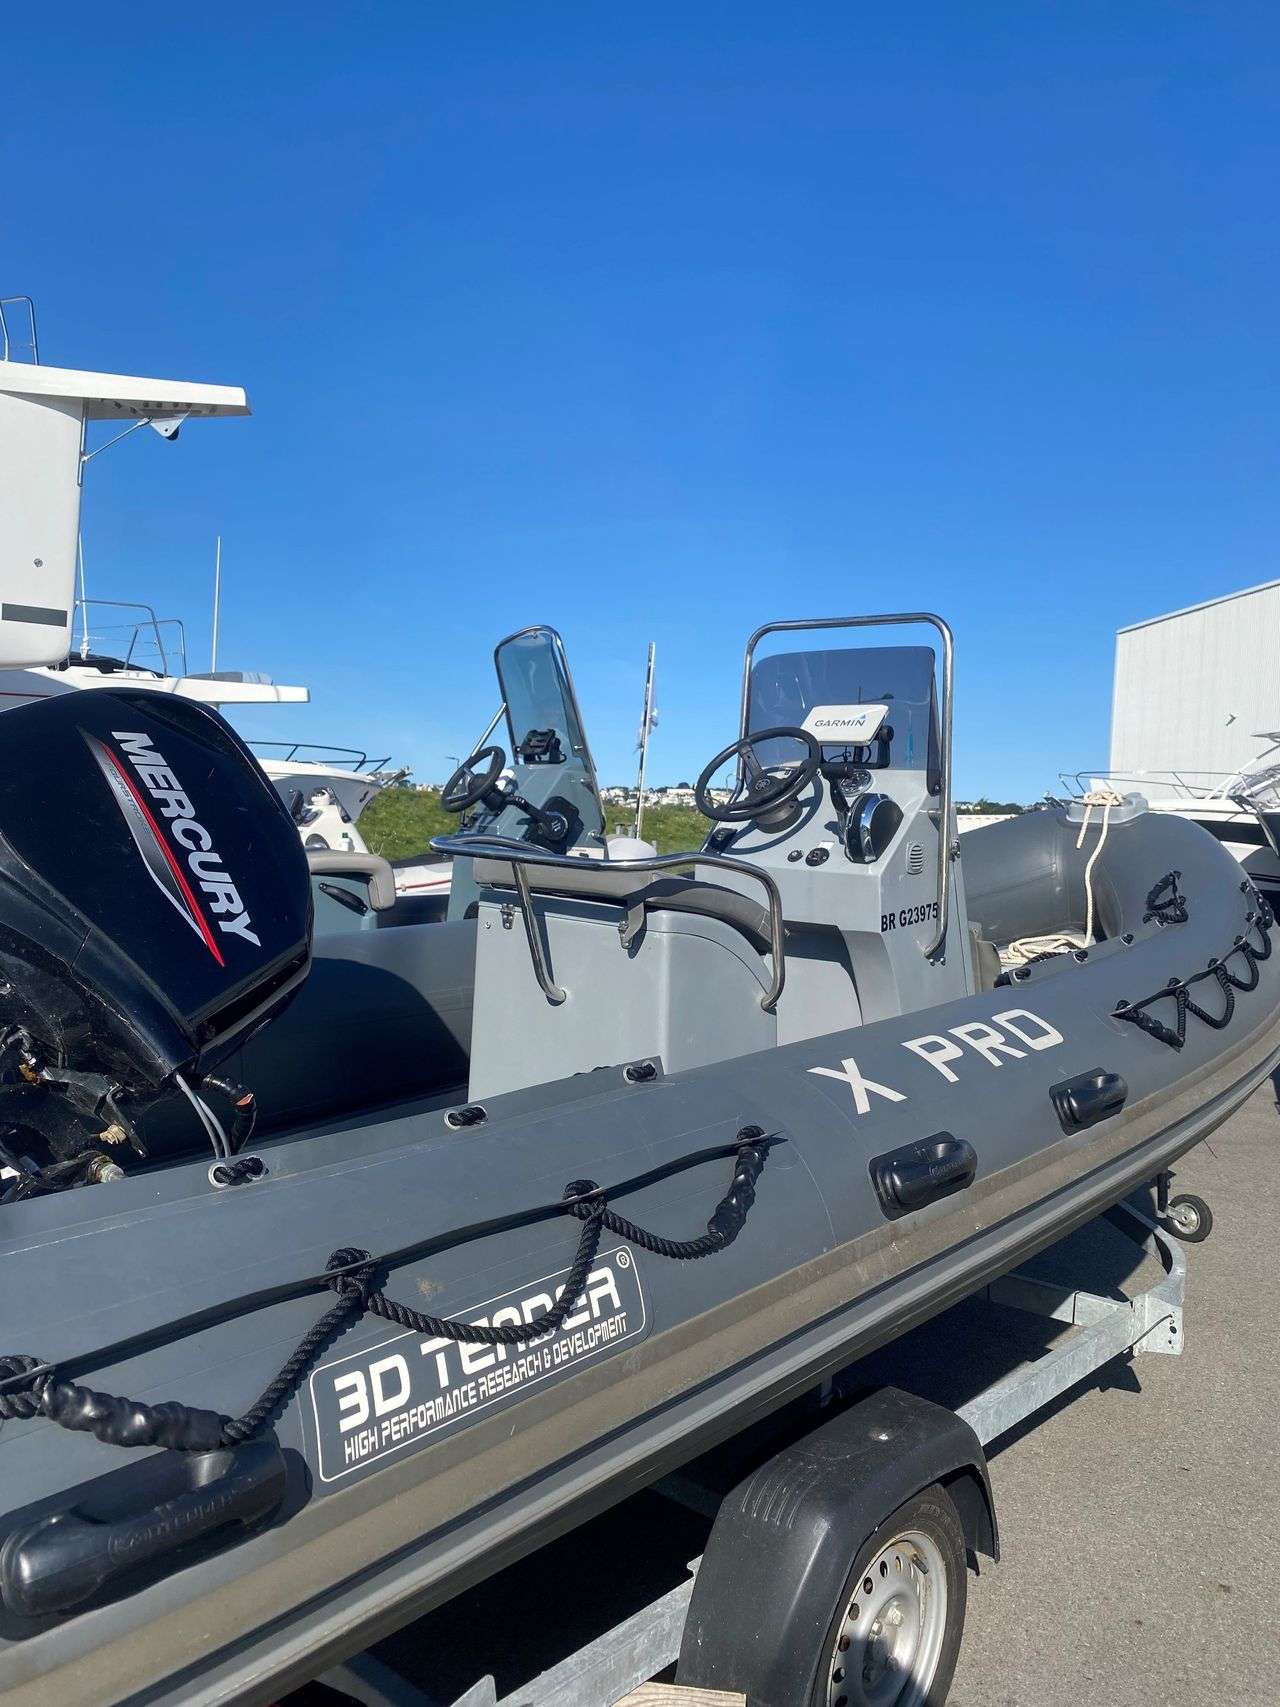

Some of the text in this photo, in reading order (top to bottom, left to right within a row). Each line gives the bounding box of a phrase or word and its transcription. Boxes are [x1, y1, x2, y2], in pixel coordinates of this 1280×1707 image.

[814, 719, 866, 728] GARMIN
[111, 731, 262, 947] MERCURY
[881, 902, 938, 933] BR G23975
[806, 1008, 1065, 1115] X PRO
[333, 1353, 412, 1433] 3D
[344, 1426, 379, 1464] HIGH
[381, 1381, 478, 1447] PERFORMANCE
[478, 1351, 543, 1400] RESEARCH
[552, 1312, 627, 1365] DEVELOPMENT
